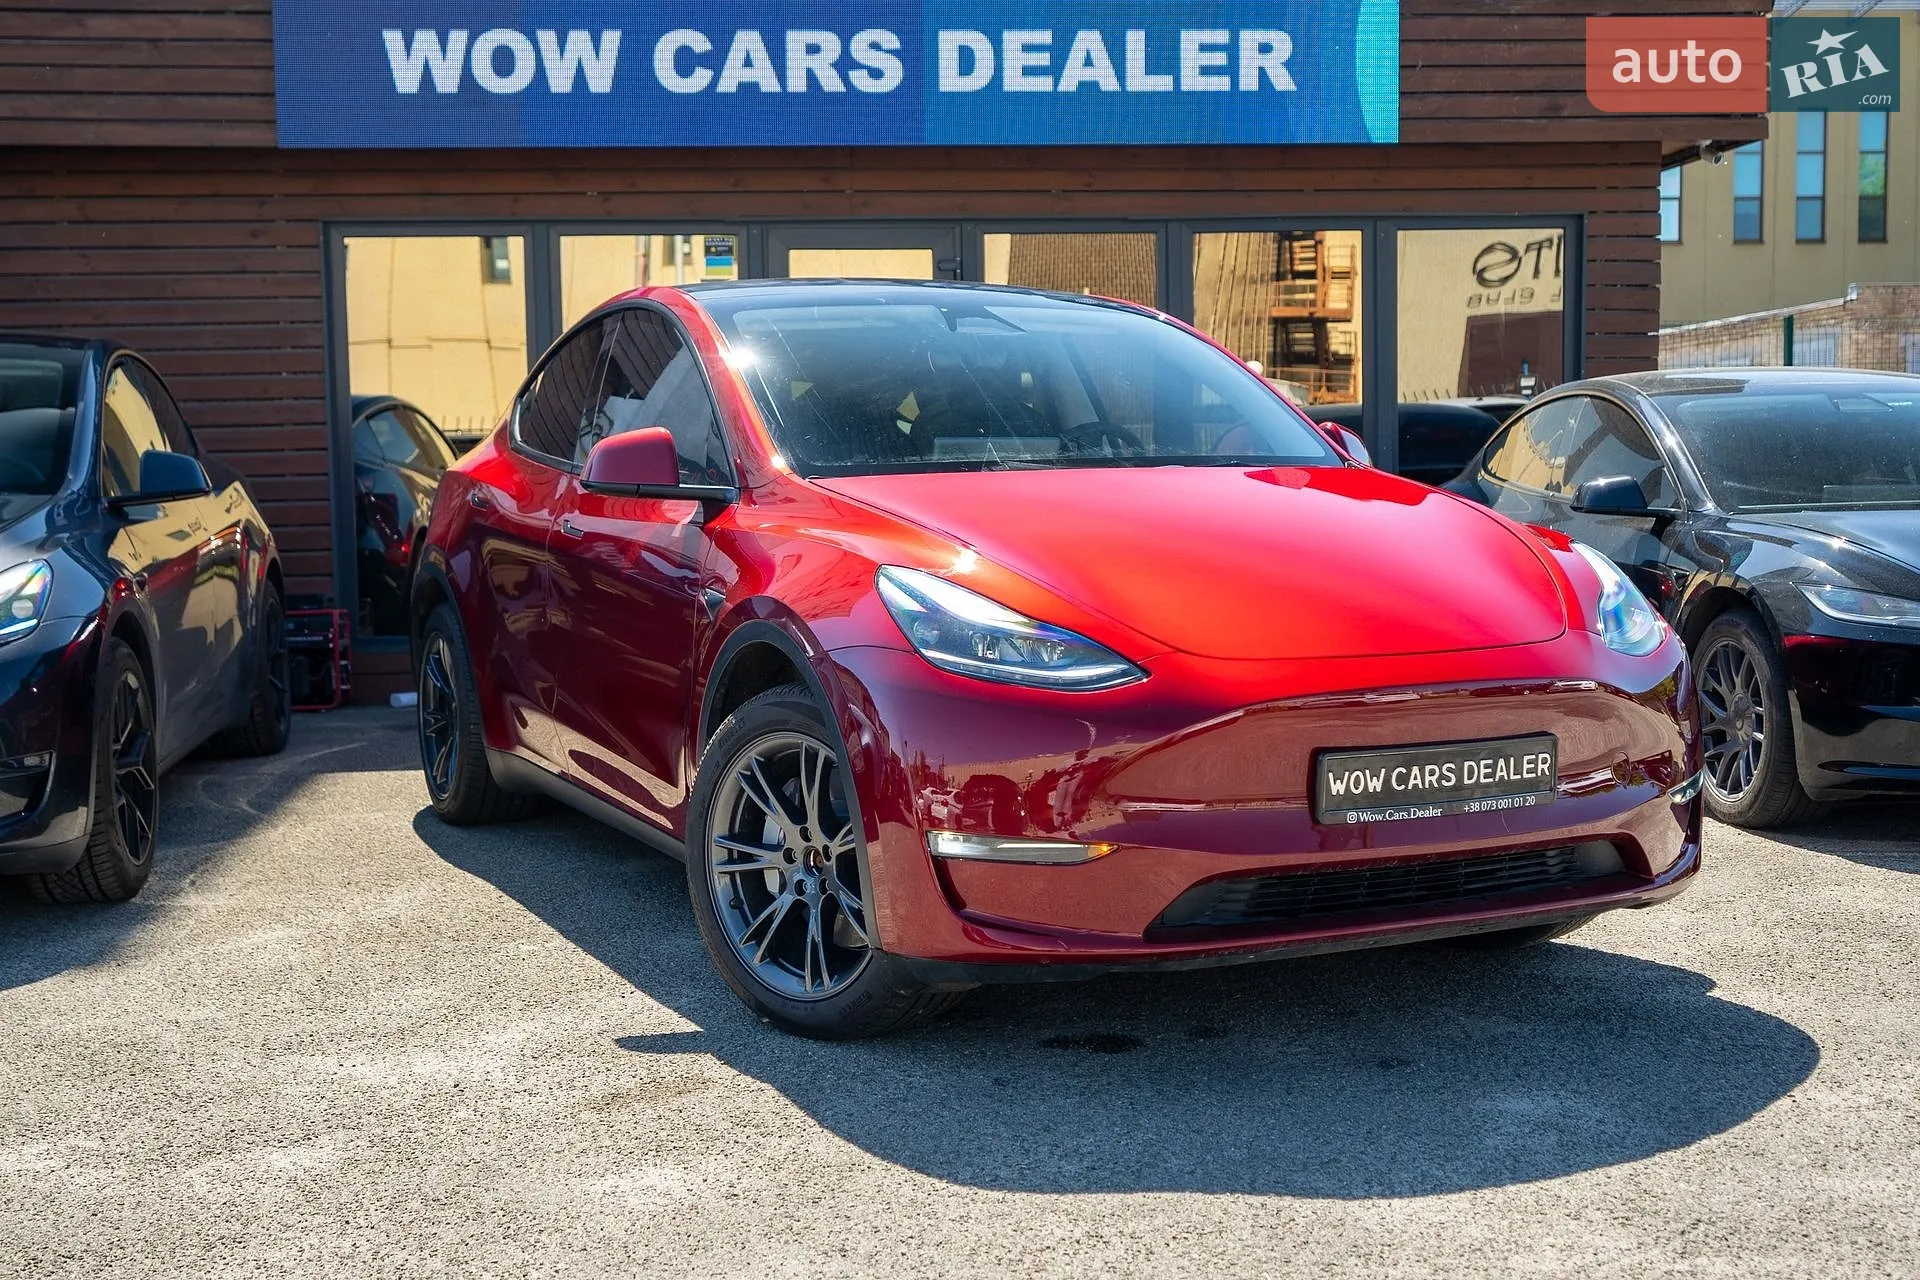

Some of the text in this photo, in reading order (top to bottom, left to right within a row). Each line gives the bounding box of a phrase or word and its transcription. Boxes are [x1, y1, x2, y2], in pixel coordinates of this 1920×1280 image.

[382, 28, 1297, 94] WOW CARS DEALER
[1328, 753, 1552, 796] WOW CARS DEALER
[1463, 796, 1536, 813] +38 073 001 01 20
